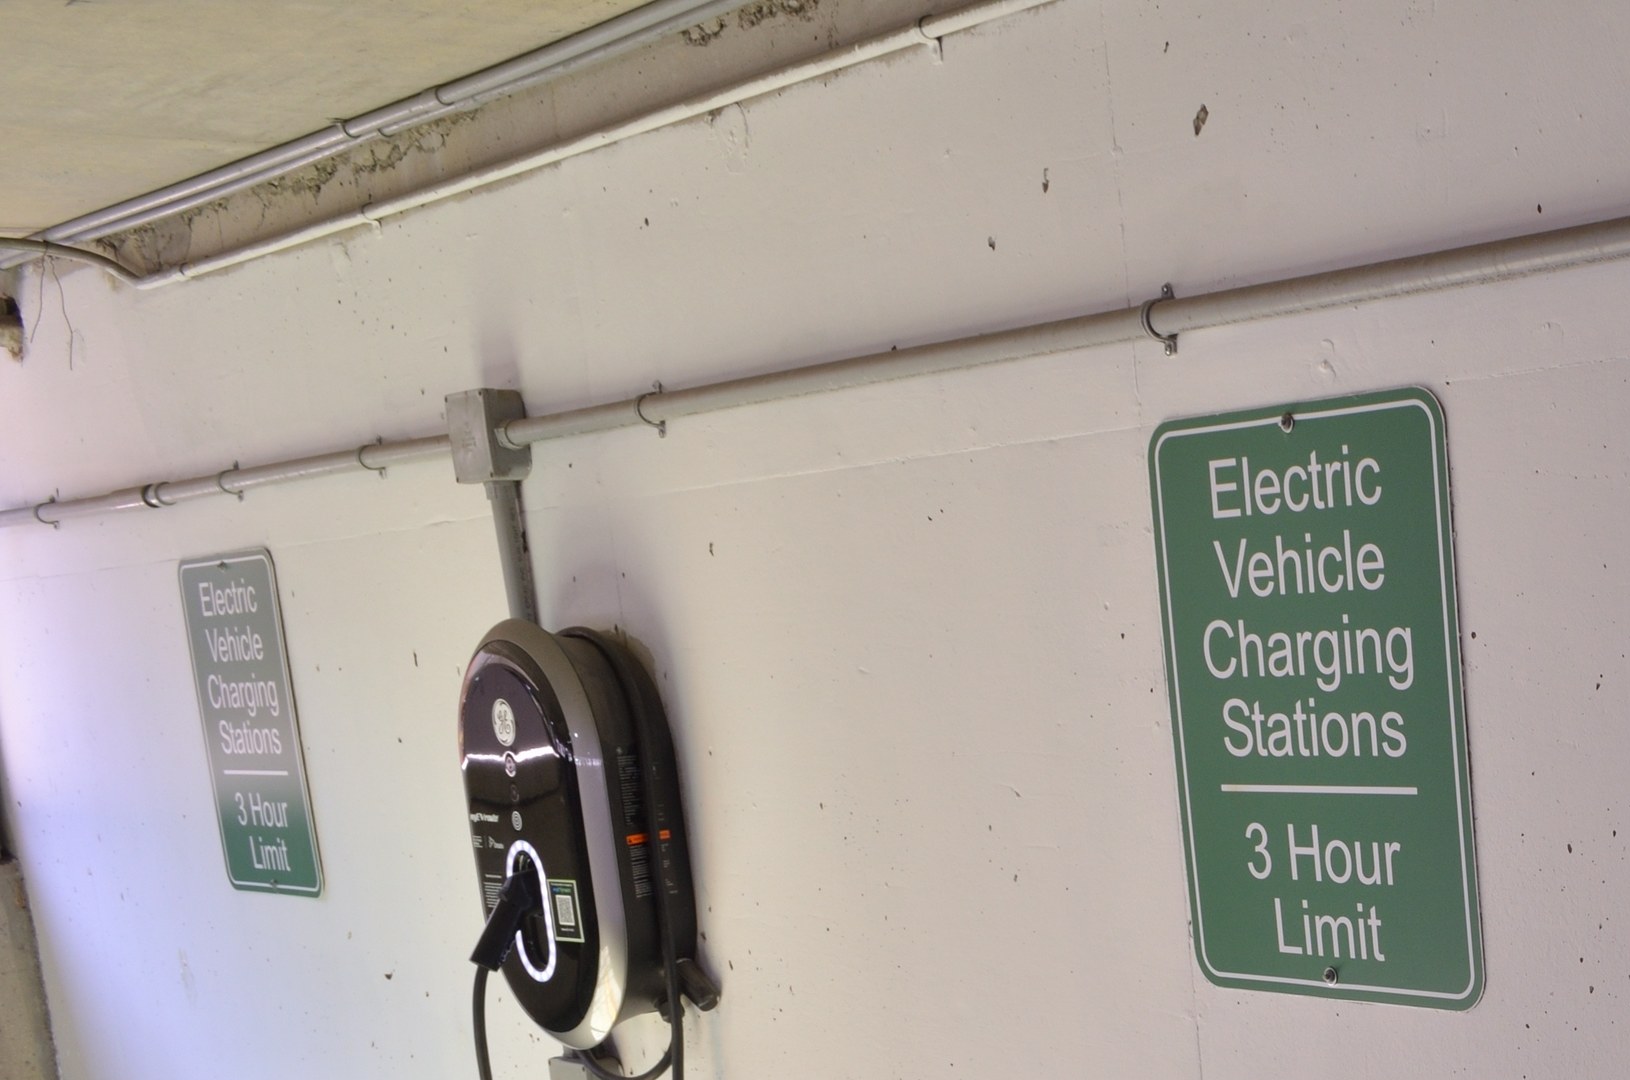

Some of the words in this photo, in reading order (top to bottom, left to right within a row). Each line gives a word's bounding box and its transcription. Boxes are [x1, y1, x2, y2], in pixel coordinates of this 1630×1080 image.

[1207, 444, 1383, 520] Electric
[1213, 530, 1385, 598] Vehicle
[199, 579, 258, 617] Electric
[205, 625, 264, 663] Vehicle
[1203, 614, 1415, 693] Charging
[207, 673, 280, 717] Charging
[219, 720, 283, 755] Stations
[1222, 697, 1408, 758] Stations
[234, 792, 248, 826] 3
[249, 791, 289, 828] Hour
[249, 835, 291, 872] Limit
[1244, 822, 1272, 880] 3
[1287, 823, 1401, 886] Hour
[1273, 897, 1386, 963] Limit
